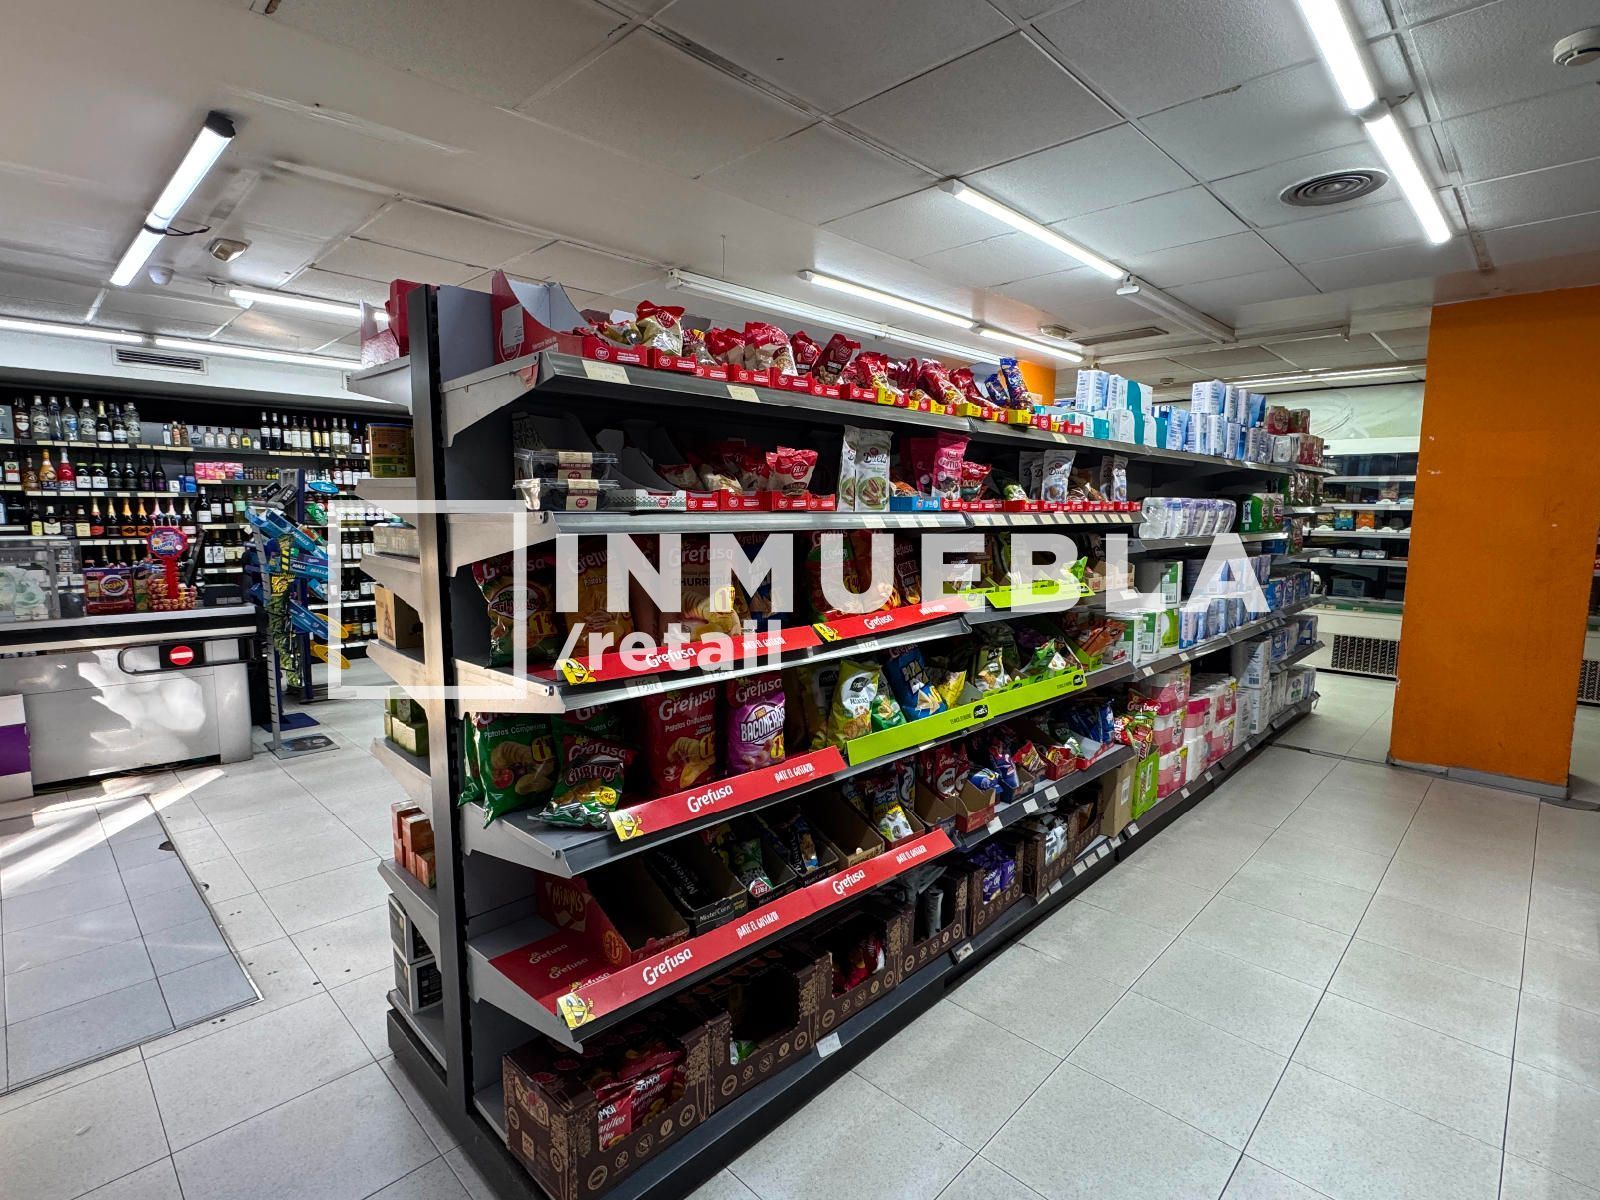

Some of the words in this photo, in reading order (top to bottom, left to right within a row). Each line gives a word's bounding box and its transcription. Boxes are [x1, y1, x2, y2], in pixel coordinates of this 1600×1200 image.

[863, 614, 894, 630] Grefusa
[645, 647, 697, 668] Grefusa
[736, 678, 783, 703] Grefusa
[659, 687, 717, 721] Grefusa
[484, 727, 510, 739] Patatas
[510, 722, 547, 736] Campesina
[568, 743, 626, 762] Grefusa
[687, 785, 734, 812] Grefusa
[832, 869, 866, 896] Grefusa
[529, 942, 568, 965] Grefusa
[549, 957, 589, 980] Grefusa
[642, 947, 693, 985] Grefusa
